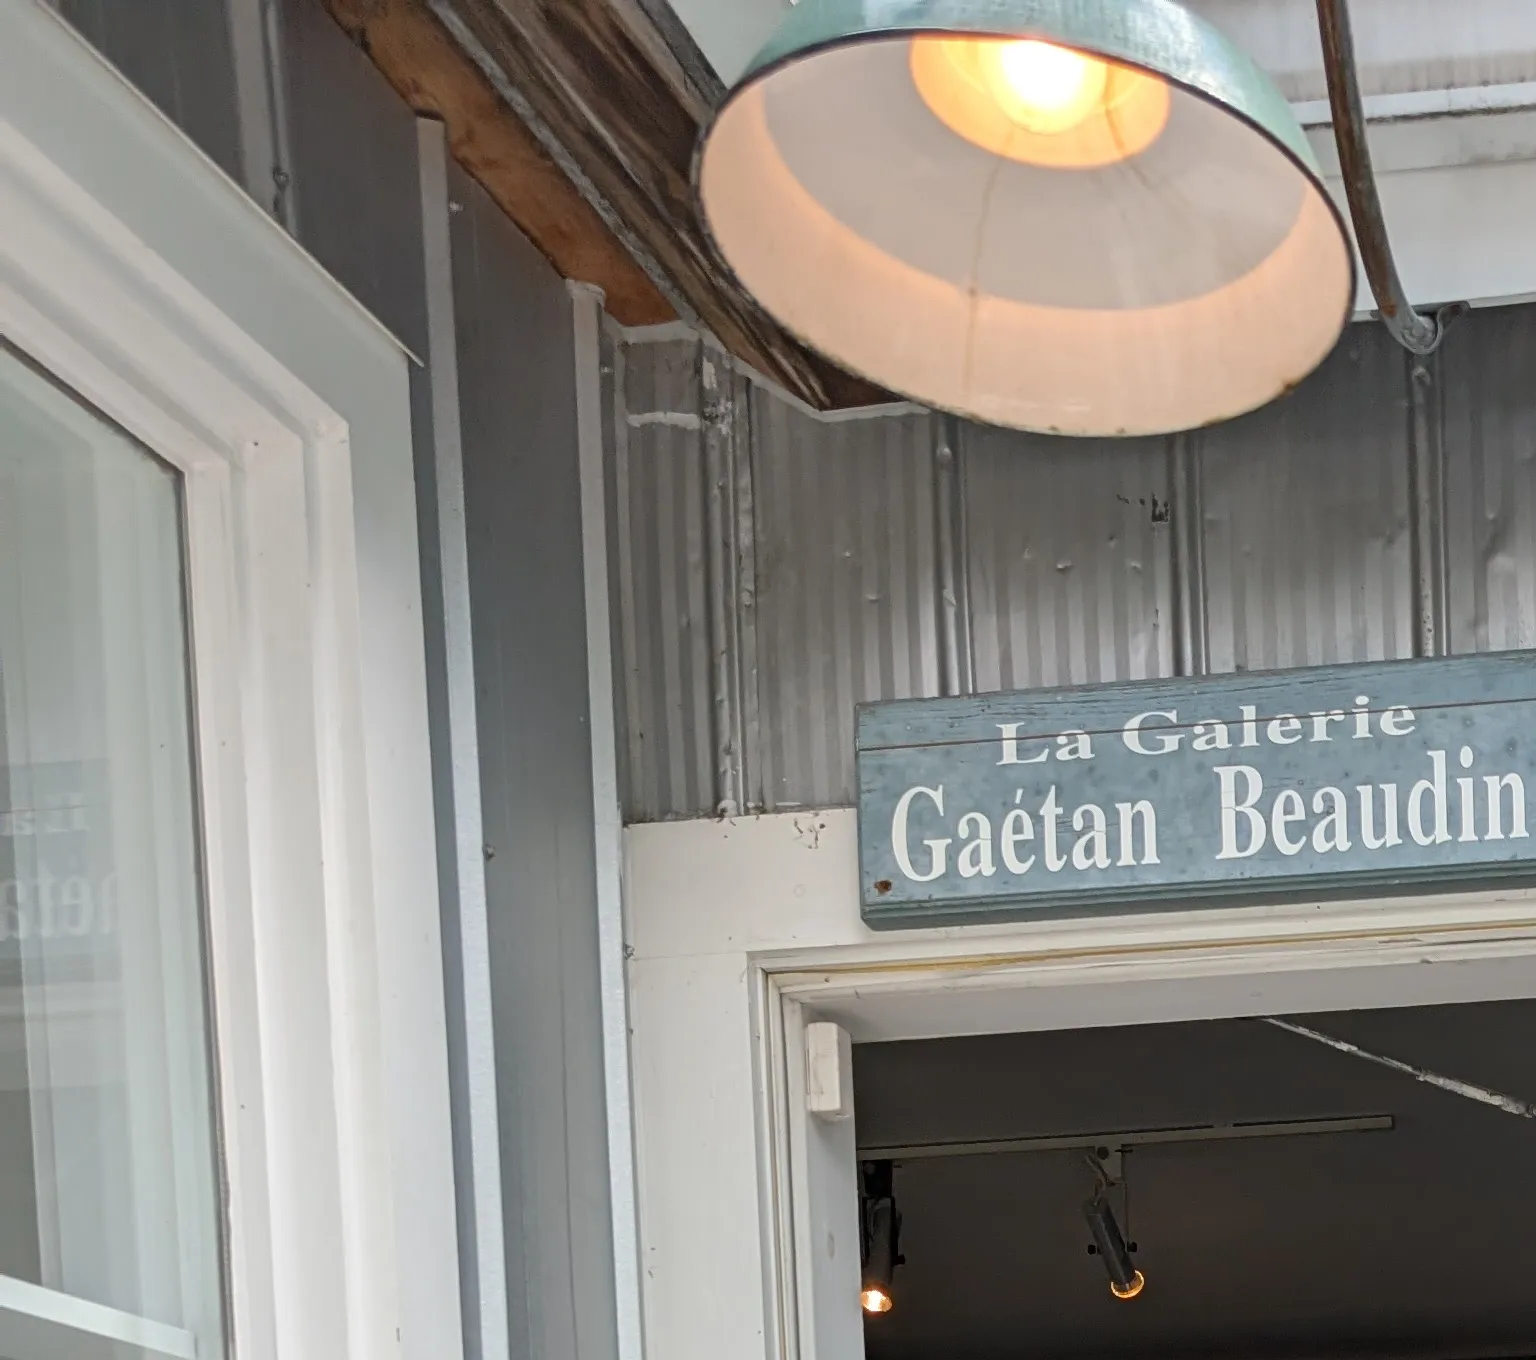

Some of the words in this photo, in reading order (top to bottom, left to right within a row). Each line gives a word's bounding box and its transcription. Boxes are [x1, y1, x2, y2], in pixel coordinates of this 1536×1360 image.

[996, 721, 1095, 766] La
[1121, 695, 1417, 756] Galerie
[891, 785, 1161, 882] Gaétan
[1213, 745, 1530, 861] Beaudin
